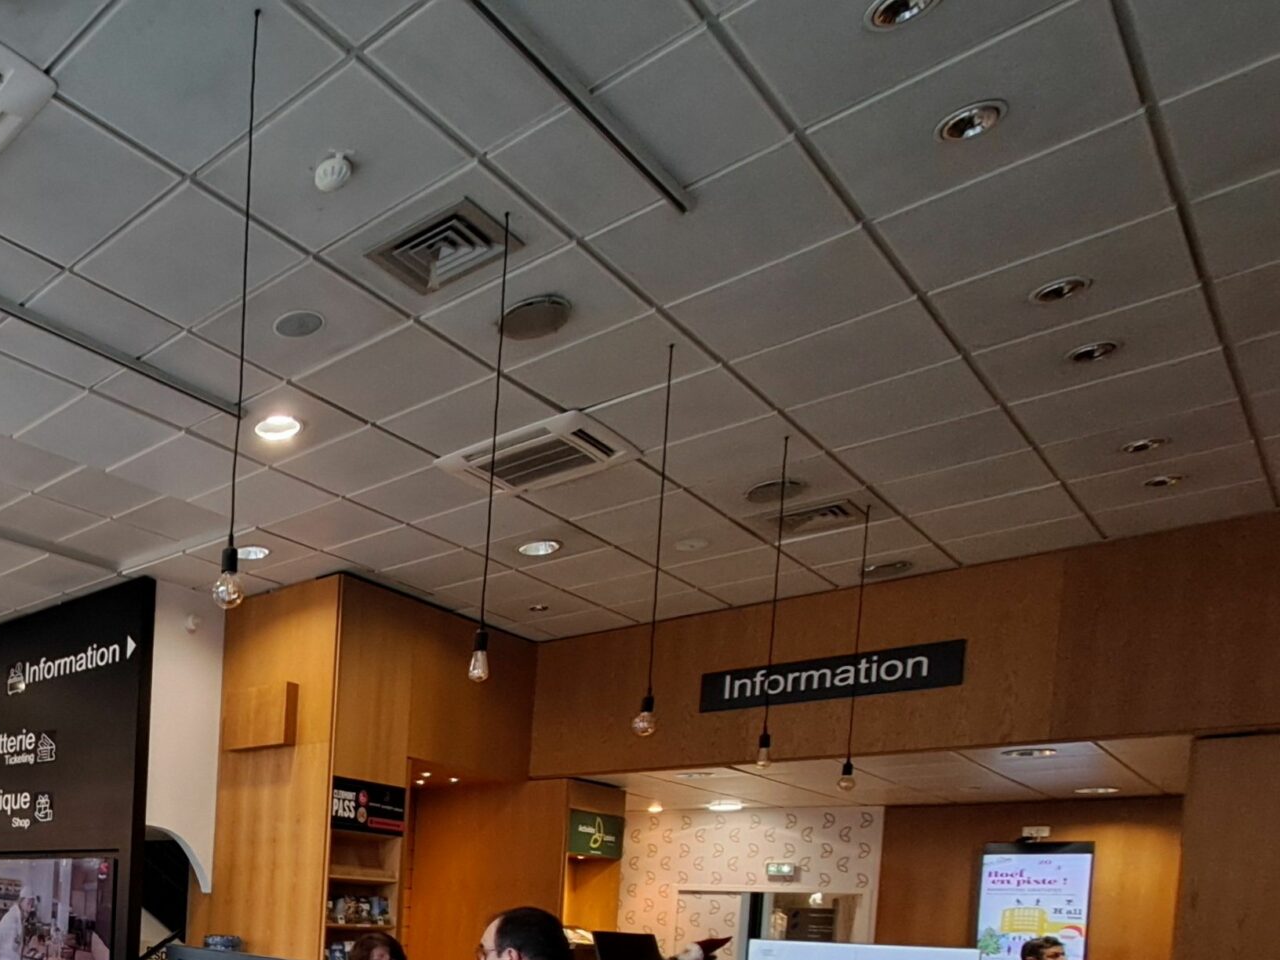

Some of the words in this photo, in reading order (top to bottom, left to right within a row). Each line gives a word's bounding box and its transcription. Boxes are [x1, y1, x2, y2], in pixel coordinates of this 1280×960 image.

[25, 643, 120, 684] Information
[723, 655, 929, 700] Information
[4, 753, 35, 765] Ticketing
[332, 798, 356, 819] PASS
[11, 817, 31, 829] Shop
